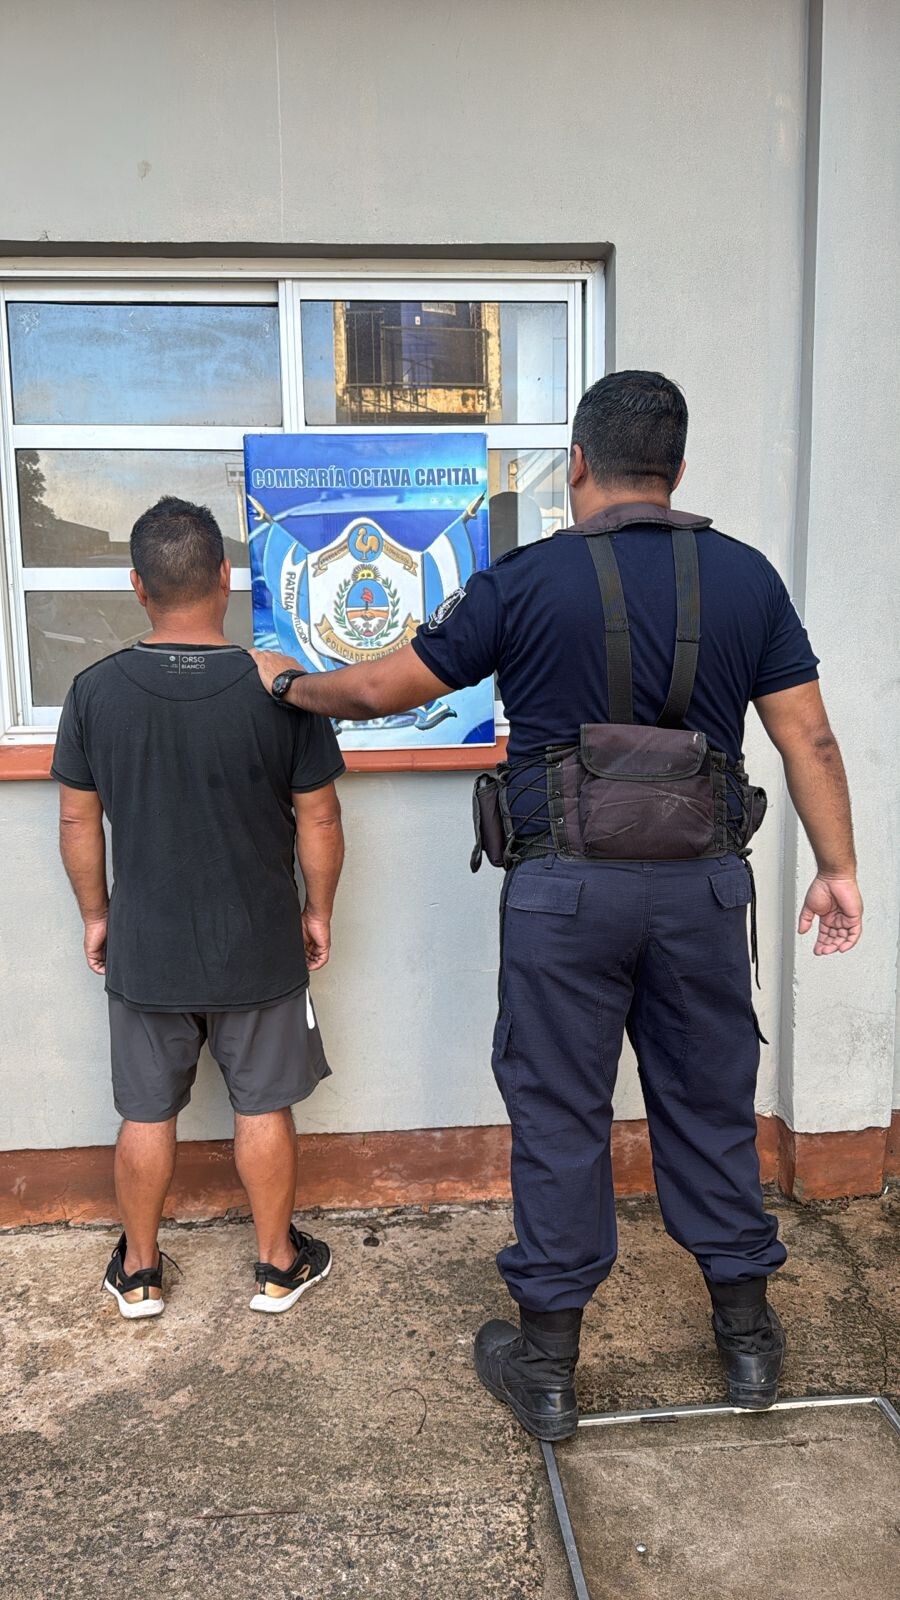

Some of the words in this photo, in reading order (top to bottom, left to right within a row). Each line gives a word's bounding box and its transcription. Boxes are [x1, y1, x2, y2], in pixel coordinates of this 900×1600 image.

[252, 465, 343, 489] COMISARÍA
[350, 467, 411, 488] OCTAVA
[414, 466, 479, 487] CAPITAL
[286, 571, 297, 611] PATRIA
[325, 636, 356, 661] POLICIA
[355, 654, 364, 662] DE
